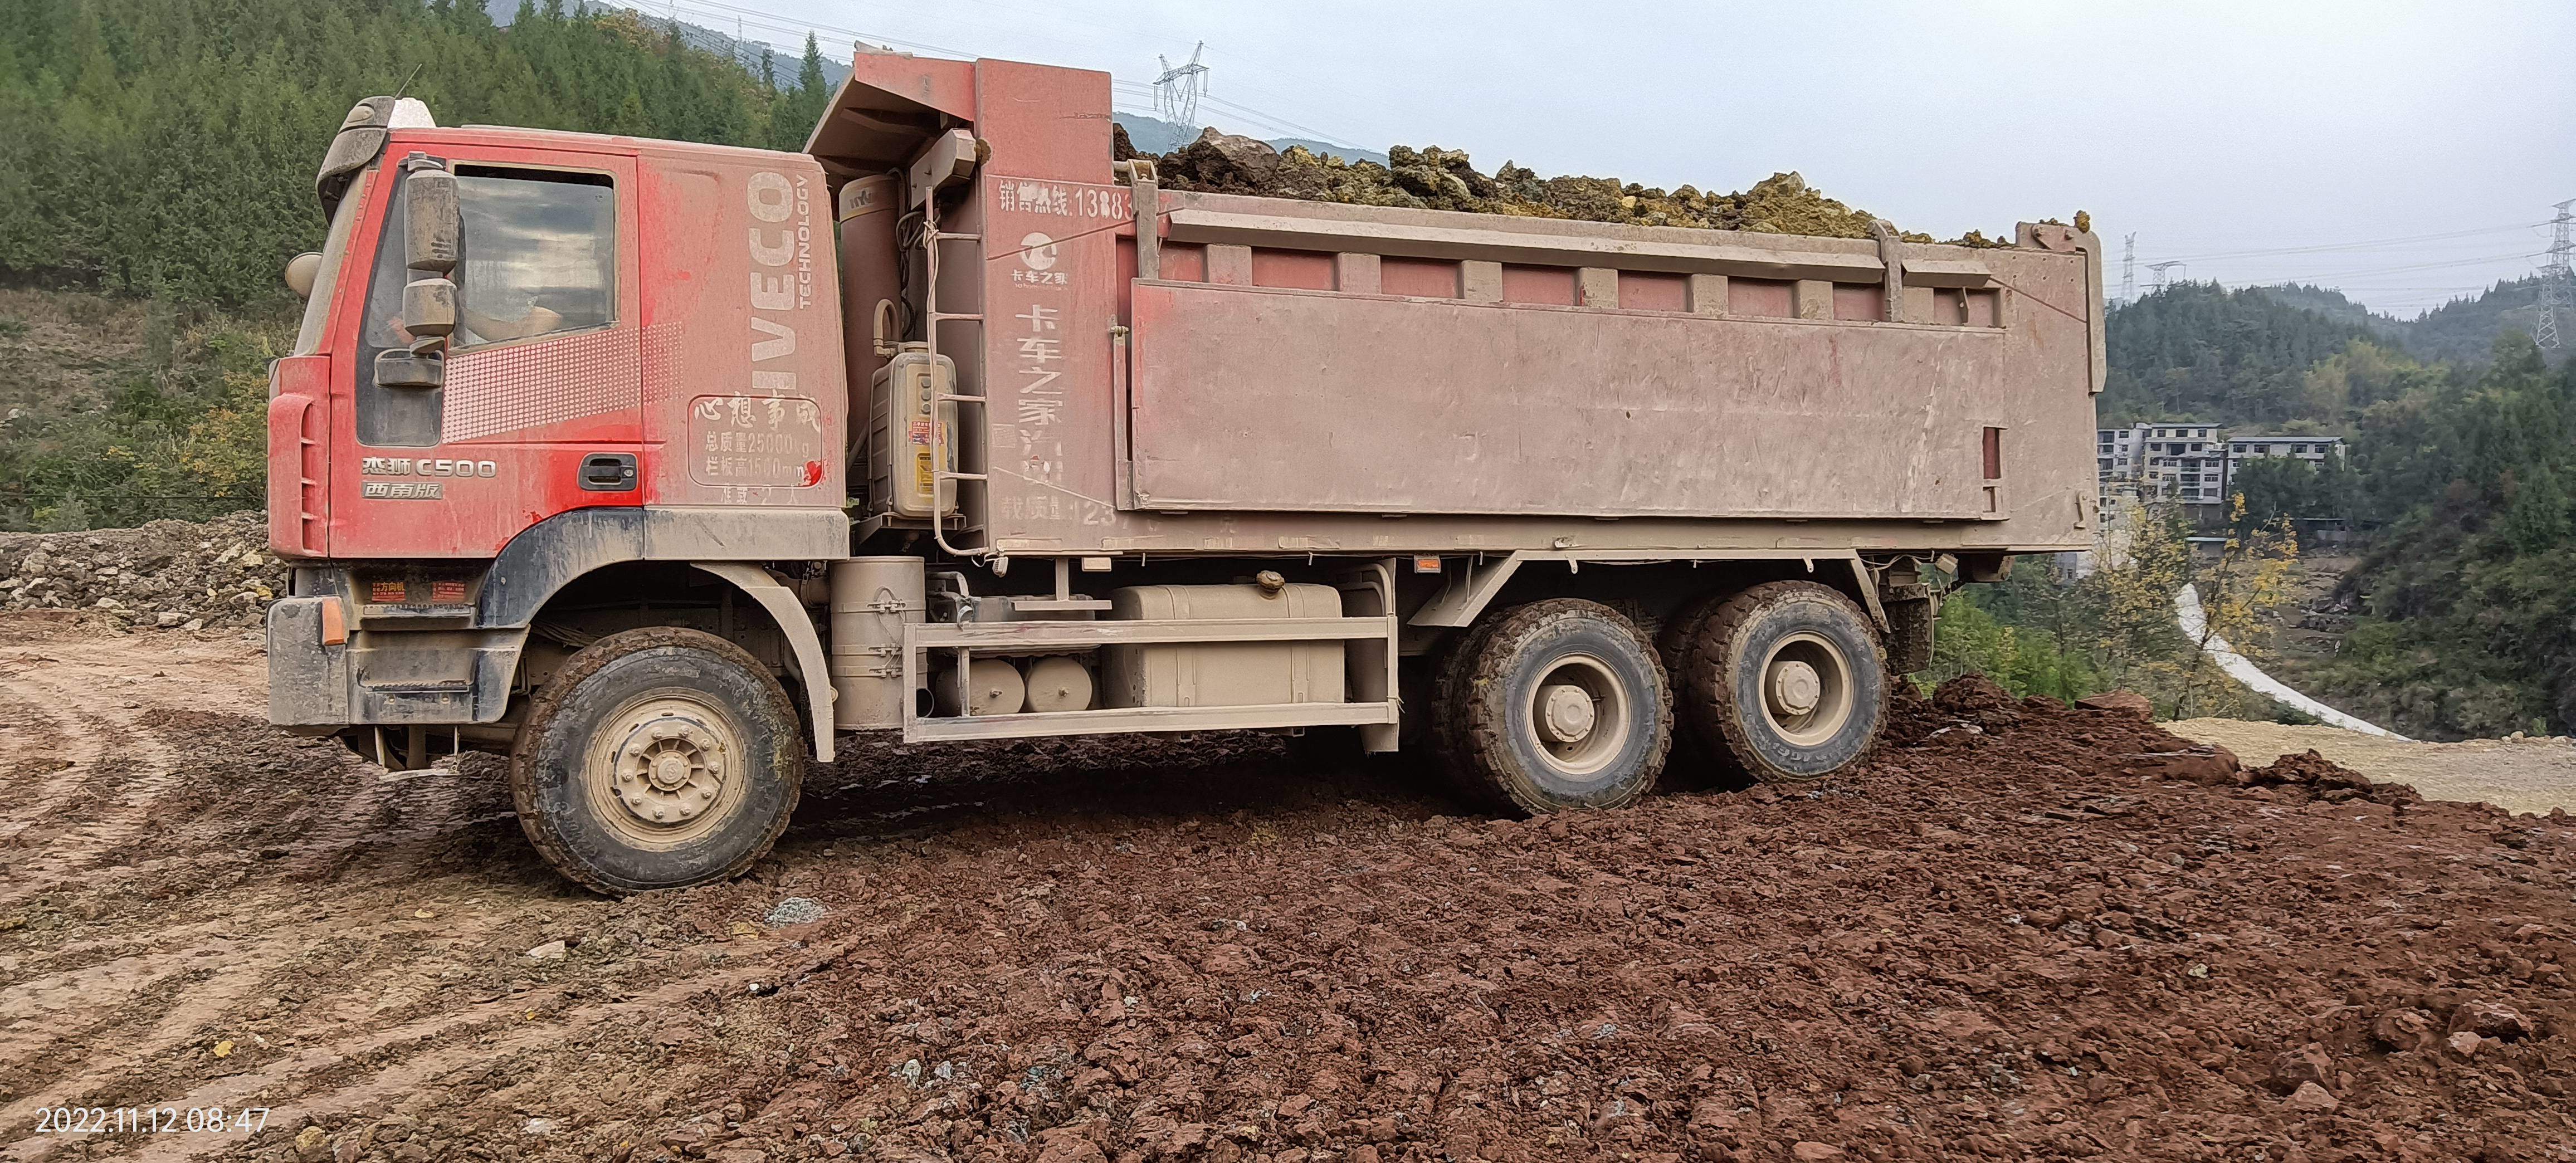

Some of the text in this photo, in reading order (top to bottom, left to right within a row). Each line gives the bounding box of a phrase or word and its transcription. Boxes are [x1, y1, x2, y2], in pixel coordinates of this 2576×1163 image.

[796, 174, 812, 310] TECHNOLOGY
[747, 172, 796, 389] IVECO
[1011, 270, 1068, 285] 卡车之家
[694, 390, 822, 433] 心想事成
[362, 457, 497, 478] 杰狮 C500
[364, 482, 440, 498] 西南版
